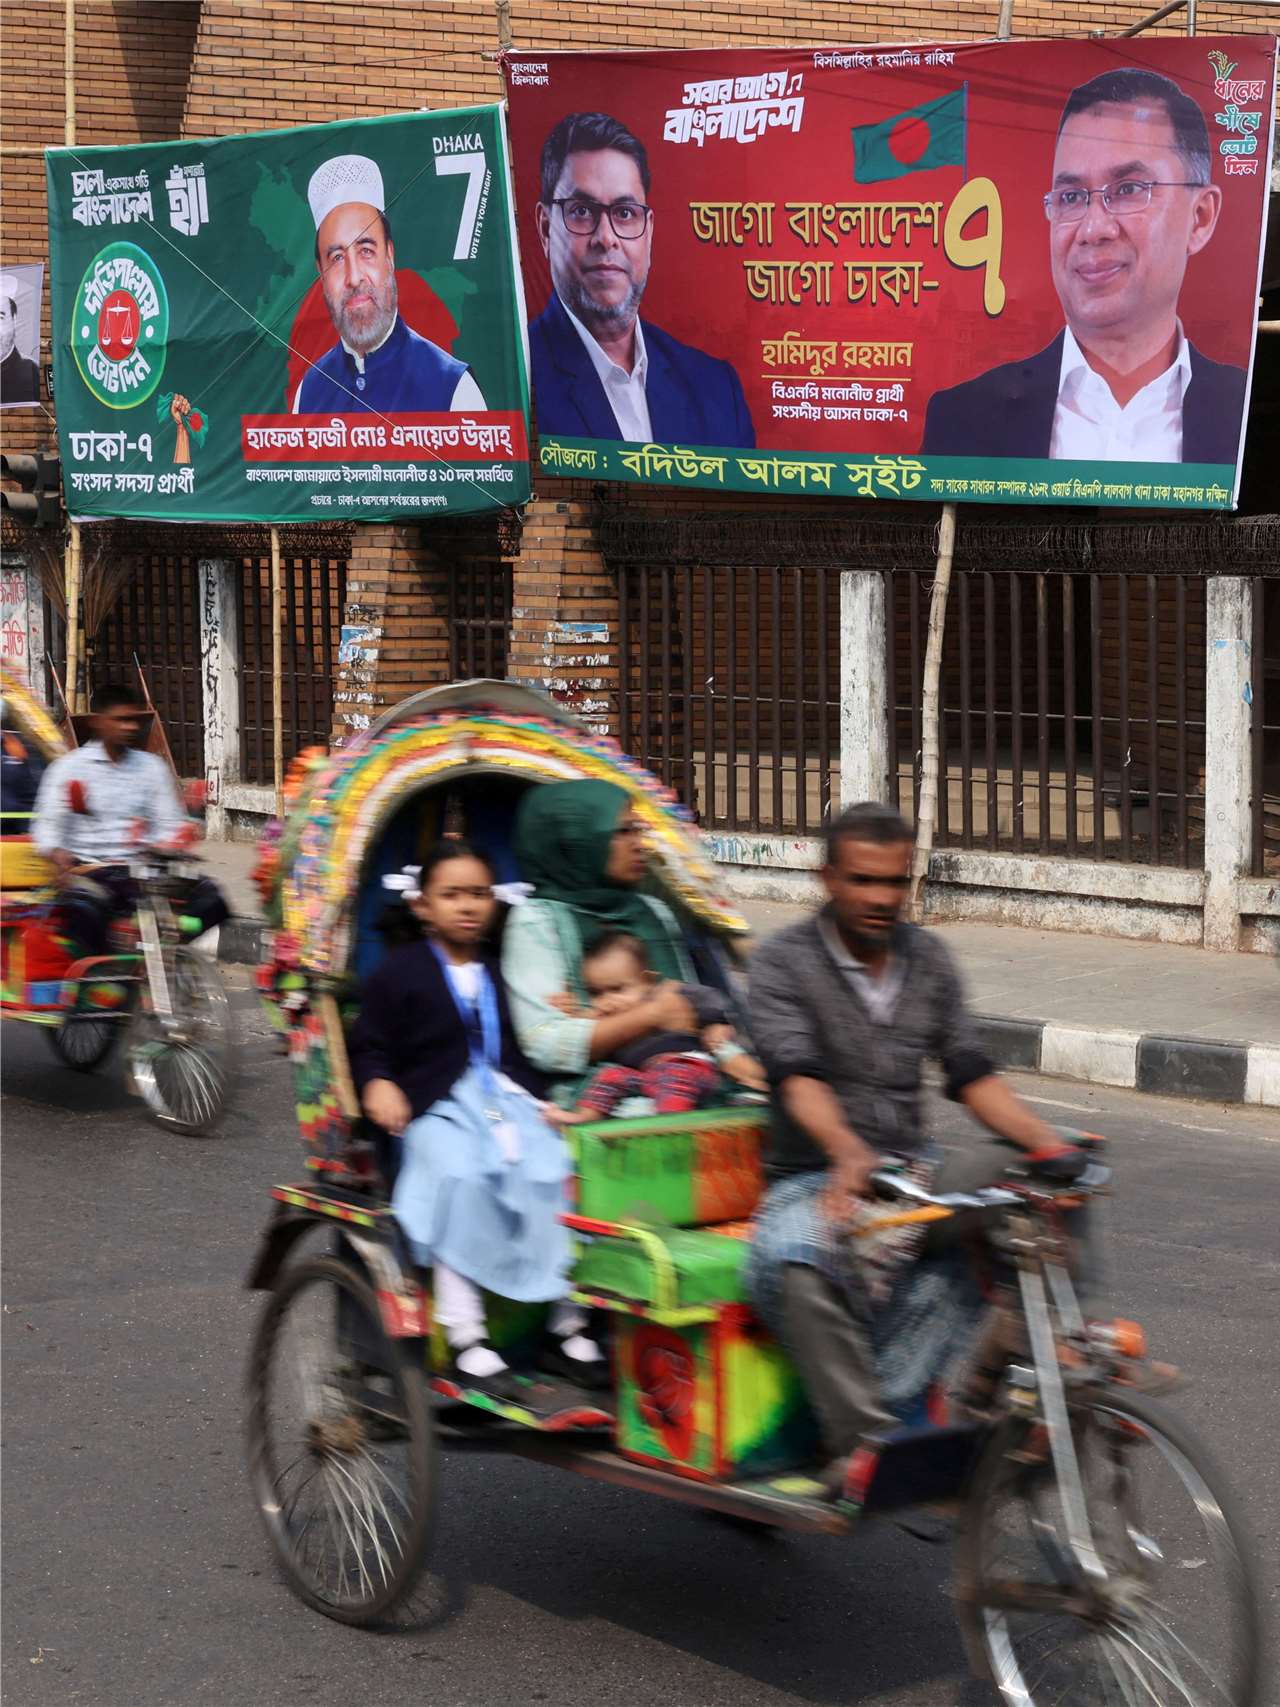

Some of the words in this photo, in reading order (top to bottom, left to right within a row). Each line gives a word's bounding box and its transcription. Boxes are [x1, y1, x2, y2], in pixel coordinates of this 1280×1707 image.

[511, 62, 548, 74] বাংলাদেশ
[814, 51, 873, 70] বিসমিল্লাহির
[877, 50, 921, 67] রহমানির
[924, 48, 955, 65] রাহিম
[511, 72, 550, 86] জিন্দাবাদ
[682, 78, 734, 105] সবার
[735, 68, 788, 101] আগে
[1215, 77, 1266, 105] ধানের
[663, 97, 804, 148] বাংলাদেশ
[1215, 104, 1262, 135] শীষে
[432, 132, 485, 154] DHAKA
[1220, 135, 1257, 154] ভোট
[1225, 155, 1258, 175] দিন
[70, 169, 105, 197] চলো
[482, 168, 493, 199] RIGHT
[71, 190, 155, 227] বাংলাদেশ
[434, 151, 487, 261] 7
[478, 197, 489, 222] YOUR
[689, 202, 776, 246] জাগো
[785, 202, 944, 248] বাংলাদেশ
[470, 236, 481, 260] VOTE
[744, 261, 834, 305] জাগো
[761, 330, 838, 376] হামিদুর
[841, 341, 913, 368] রহমান
[771, 381, 819, 400] বিএনপি
[821, 383, 873, 401] মনোনীত
[875, 383, 904, 404] প্রার্থী
[772, 401, 822, 420] সংসদীয়
[824, 407, 861, 421] আসন
[863, 407, 908, 423] ঢাকা-৭
[68, 429, 153, 463] ঢাকা-৭
[246, 427, 305, 450] হাফেজ
[305, 417, 348, 450] হাজী
[350, 426, 387, 448] মোঃ
[390, 426, 460, 451] এনায়েত
[70, 472, 113, 493] সংসদ
[114, 473, 155, 494] সদস্য
[156, 466, 195, 495] প্রার্থী
[245, 468, 293, 483] বাংলাদেশ
[293, 468, 341, 485] জামায়াতে
[341, 464, 382, 484] ইসলামী
[382, 464, 428, 483] মনোনীত
[428, 469, 438, 482] ও
[438, 470, 455, 482] ১০
[455, 469, 475, 483] দল
[475, 464, 514, 483] সমর্থিত
[617, 443, 729, 484] বদিউল
[735, 457, 837, 490] আলম
[844, 455, 927, 499] সুইট
[945, 478, 969, 494] সাবেক
[996, 480, 1028, 496] সম্পাদক
[1050, 478, 1073, 497] ওয়ার্ড
[1073, 478, 1102, 498] বিএনপি
[1103, 483, 1134, 499] লালবাগ
[1134, 484, 1152, 500] থানা
[1153, 485, 1171, 501] ঢাকা
[1172, 485, 1205, 503] মহানগর
